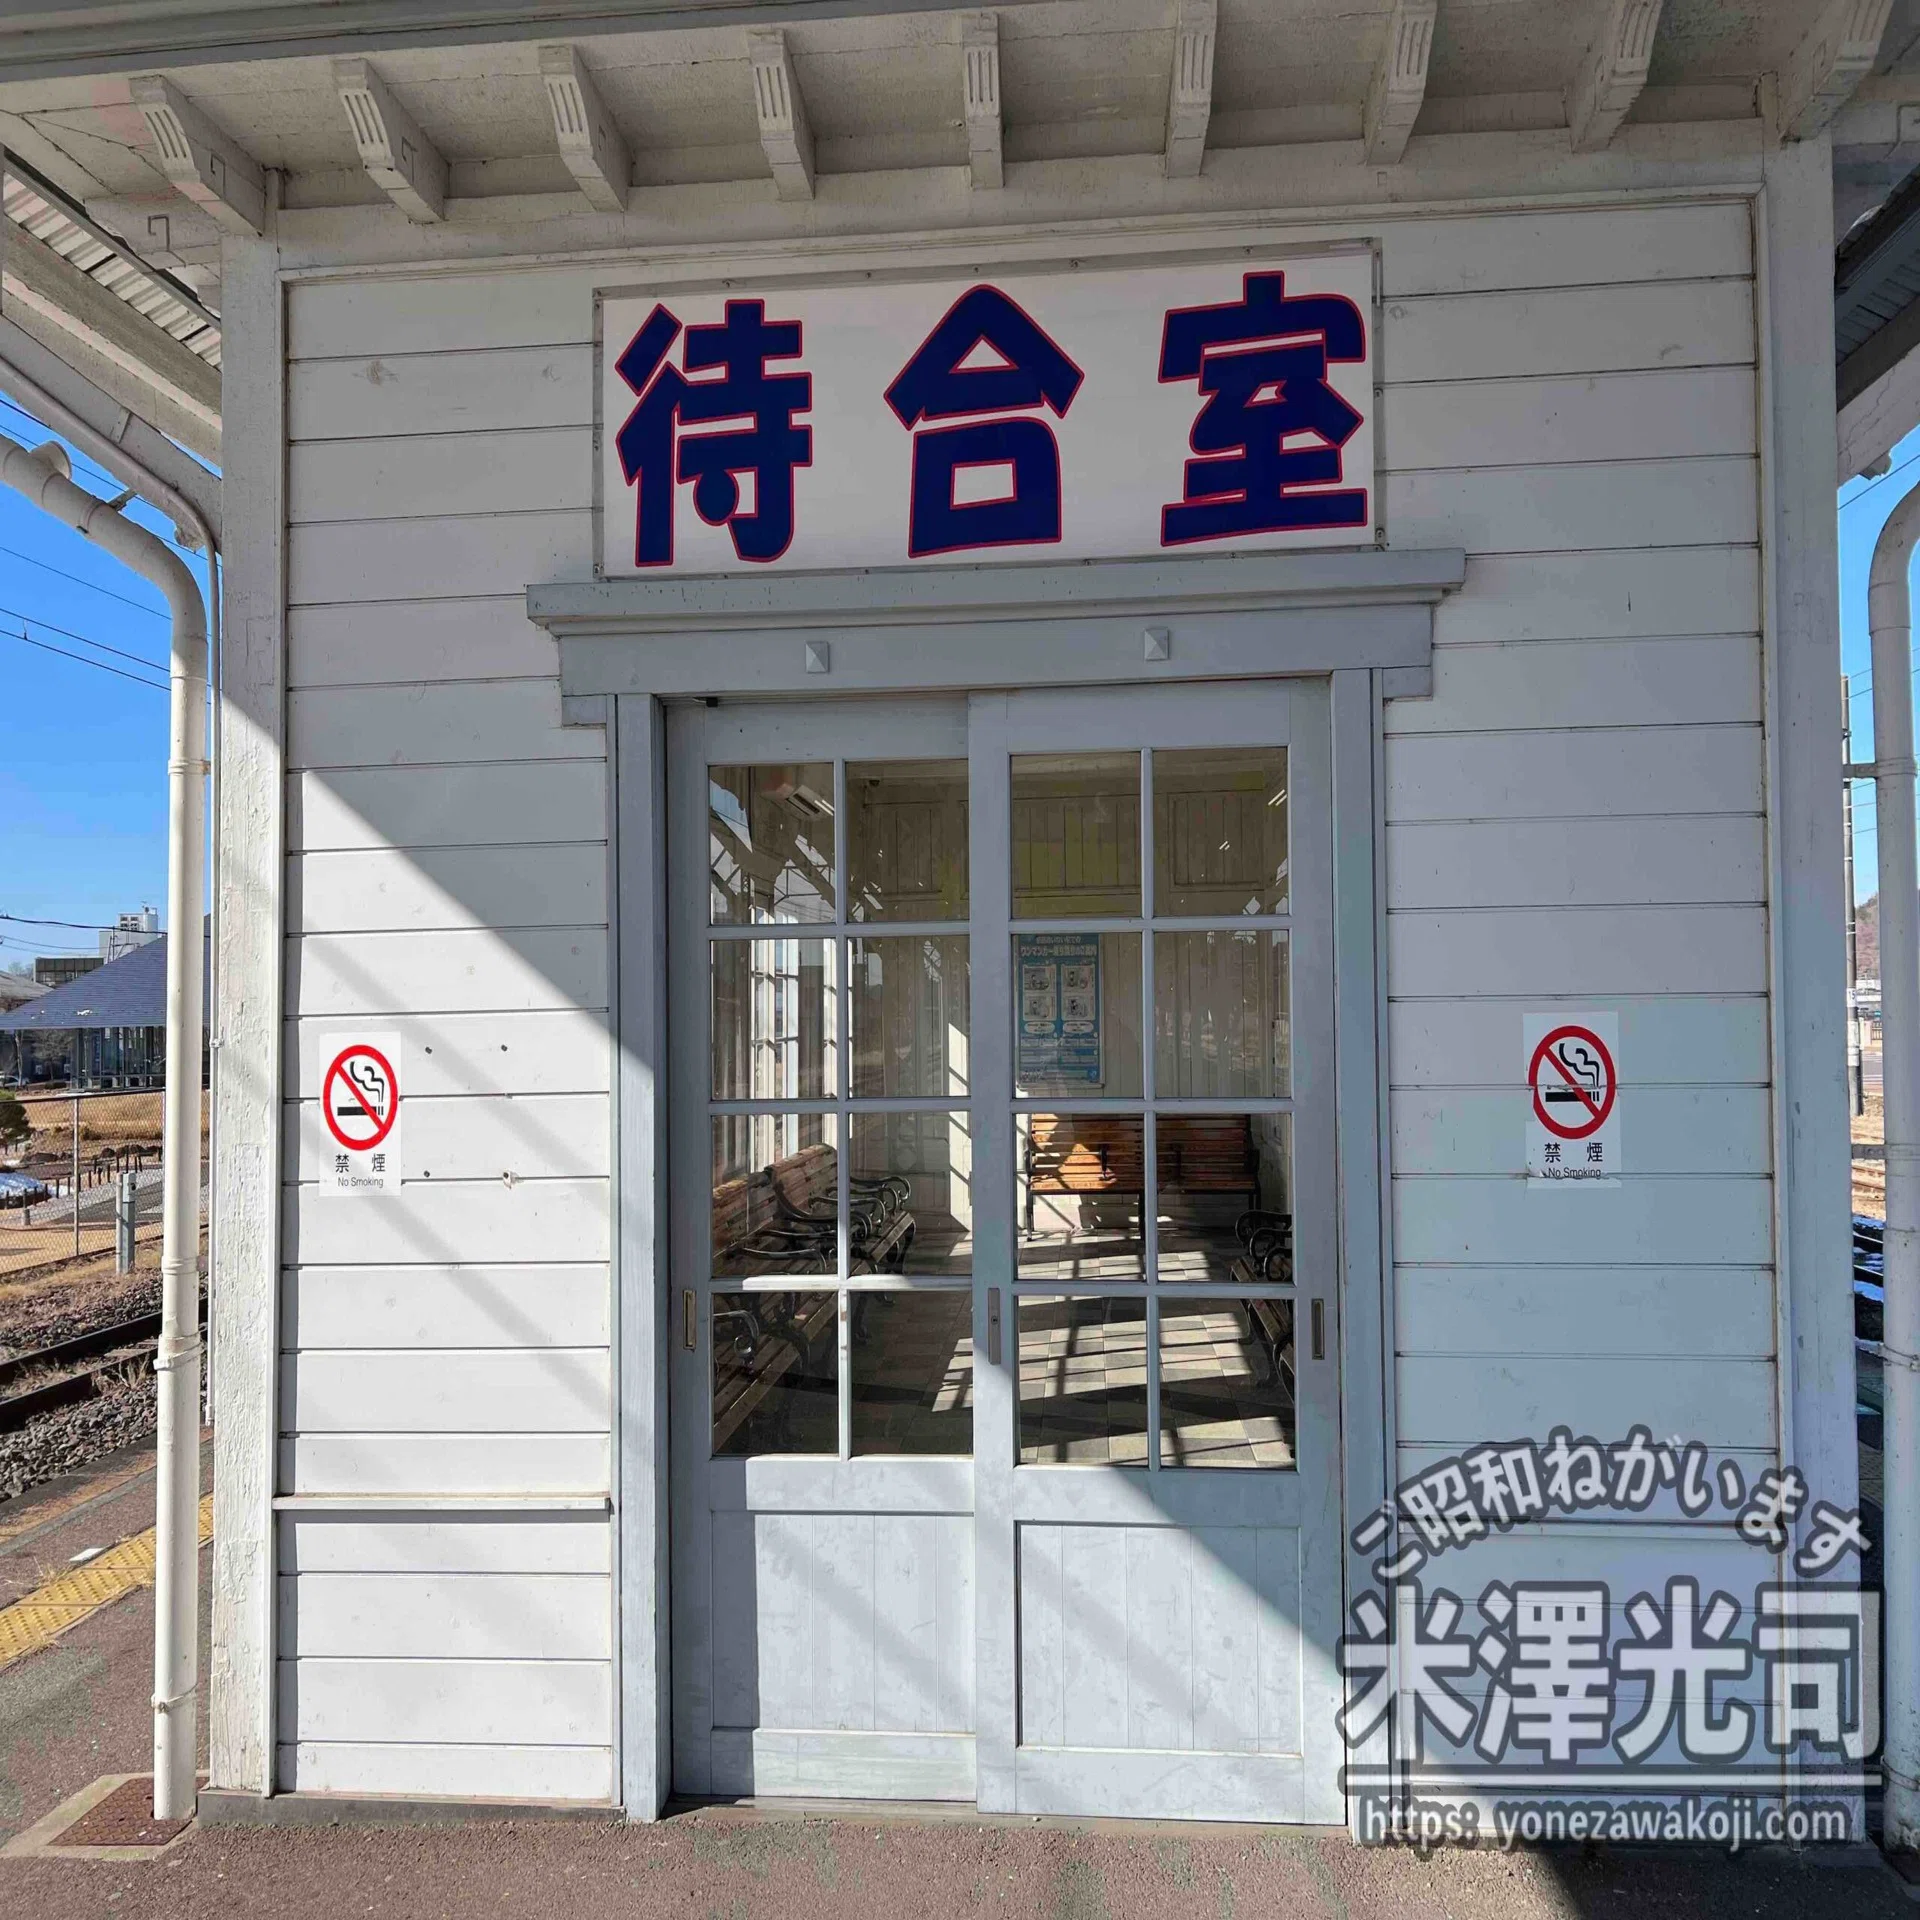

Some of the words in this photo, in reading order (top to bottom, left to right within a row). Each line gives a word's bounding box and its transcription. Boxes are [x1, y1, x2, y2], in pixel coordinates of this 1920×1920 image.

[614, 270, 1367, 567] 待合室
[1544, 1142, 1603, 1163] 禁煙
[335, 1153, 386, 1173] 禁煙
[337, 1177, 349, 1187] No
[350, 1176, 384, 1189] Smoking
[1548, 1168, 1561, 1178] No
[1563, 1167, 1602, 1180] Smoking
